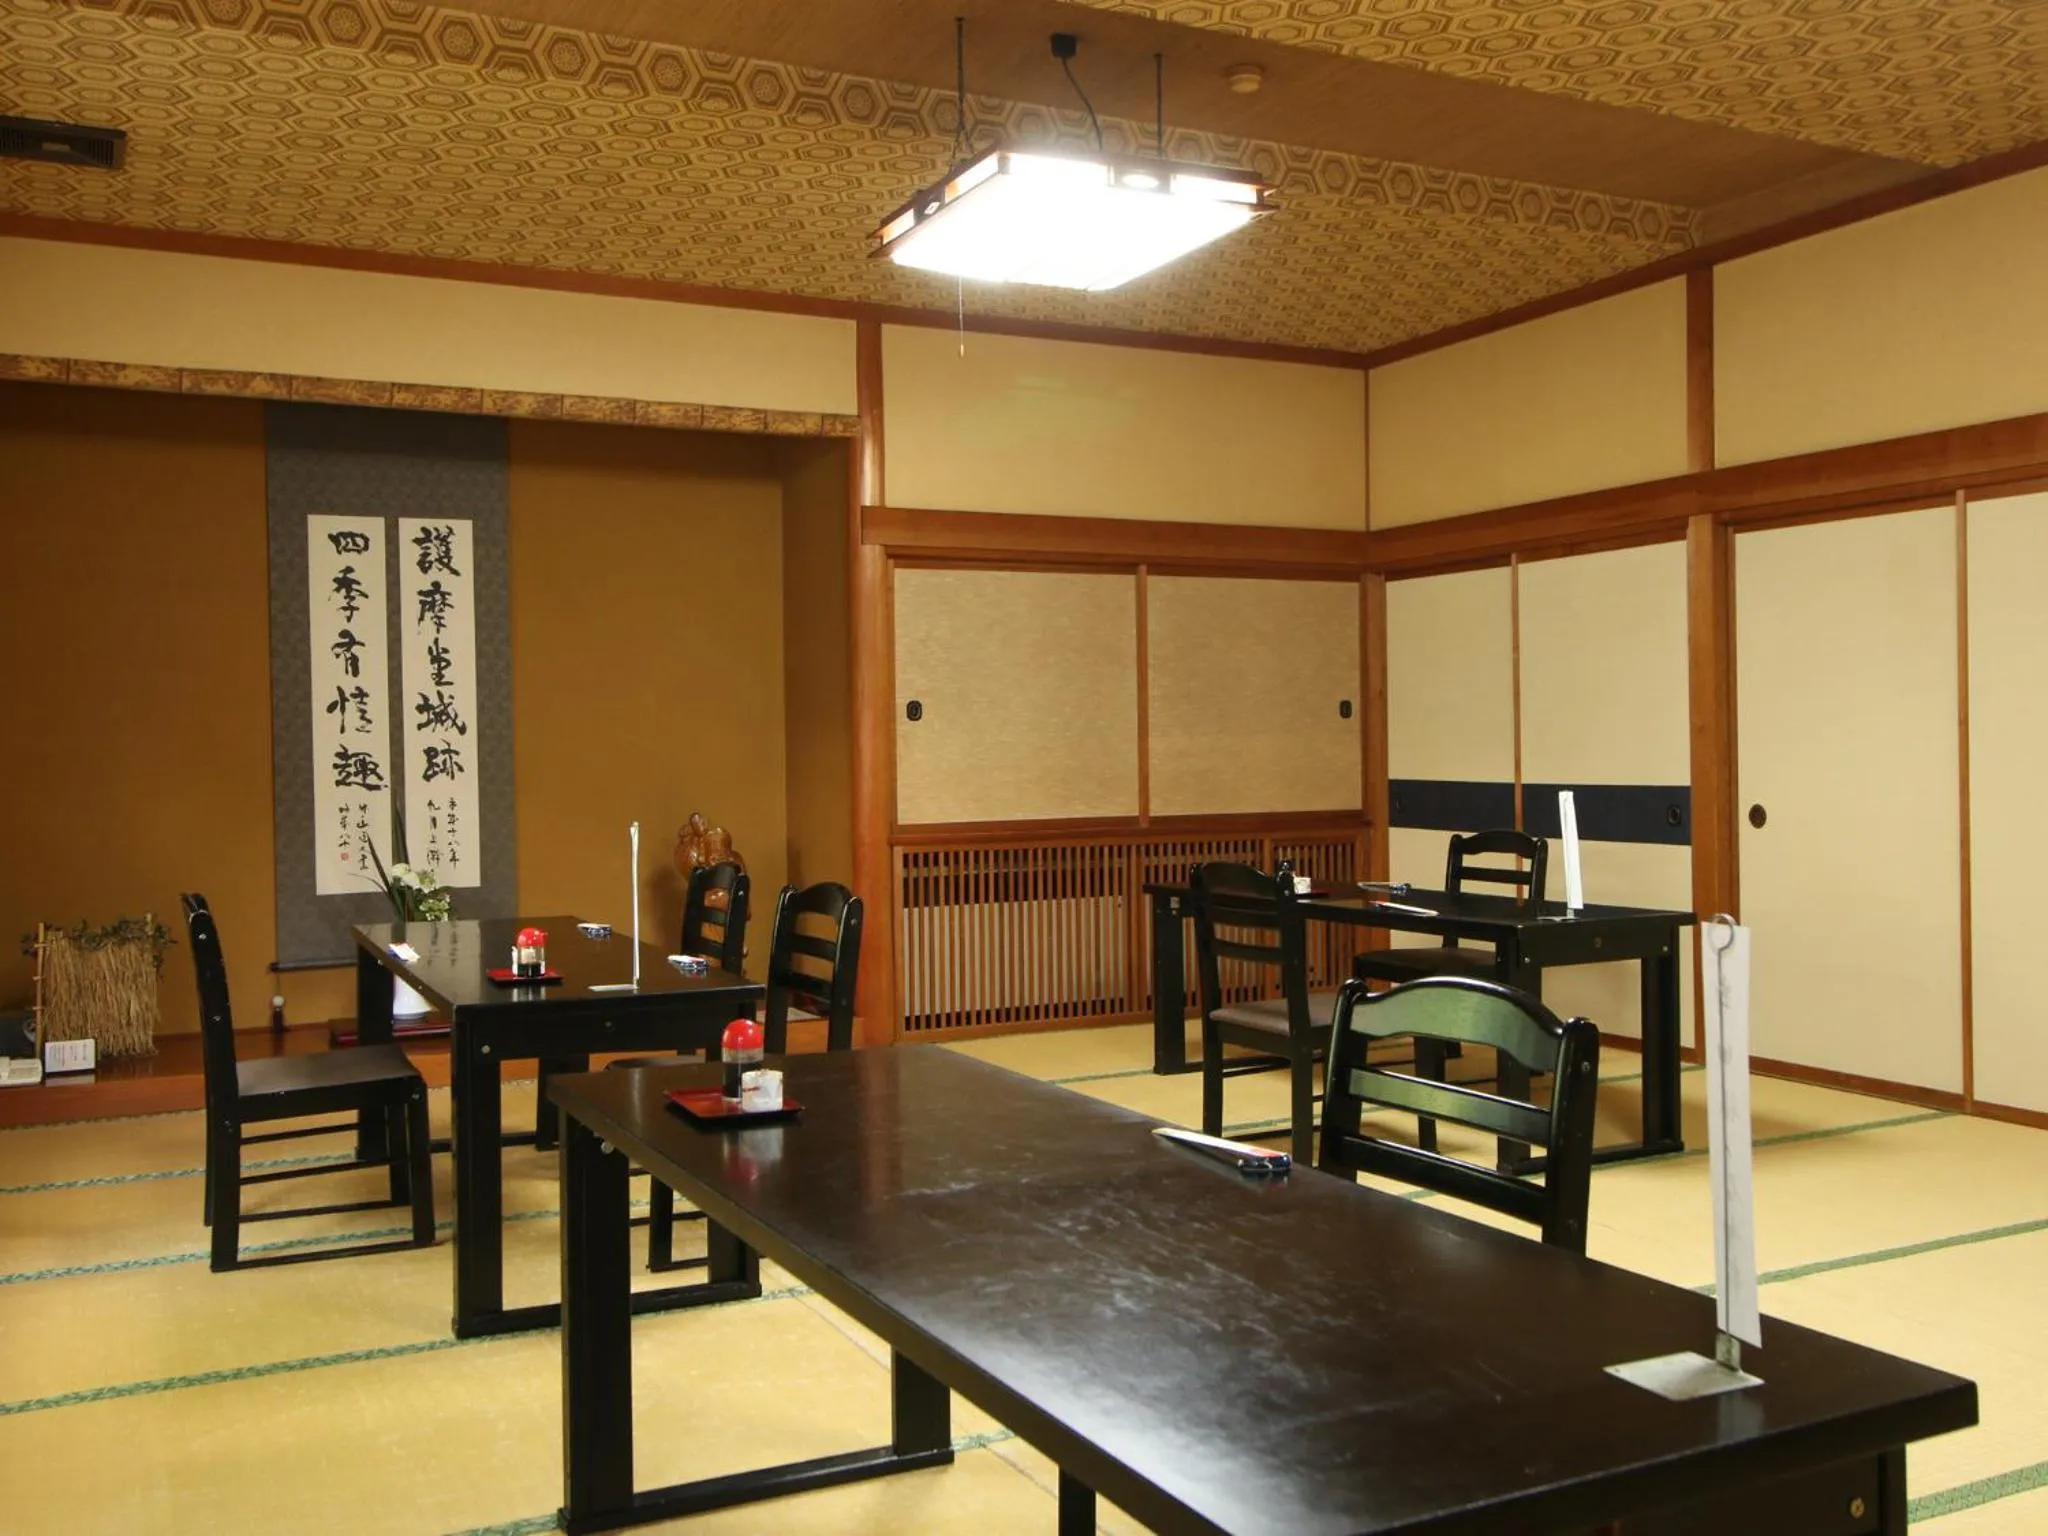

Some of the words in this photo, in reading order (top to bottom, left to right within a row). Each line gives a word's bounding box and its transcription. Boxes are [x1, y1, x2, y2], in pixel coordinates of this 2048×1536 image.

[326, 530, 389, 791] 四季有情趣
